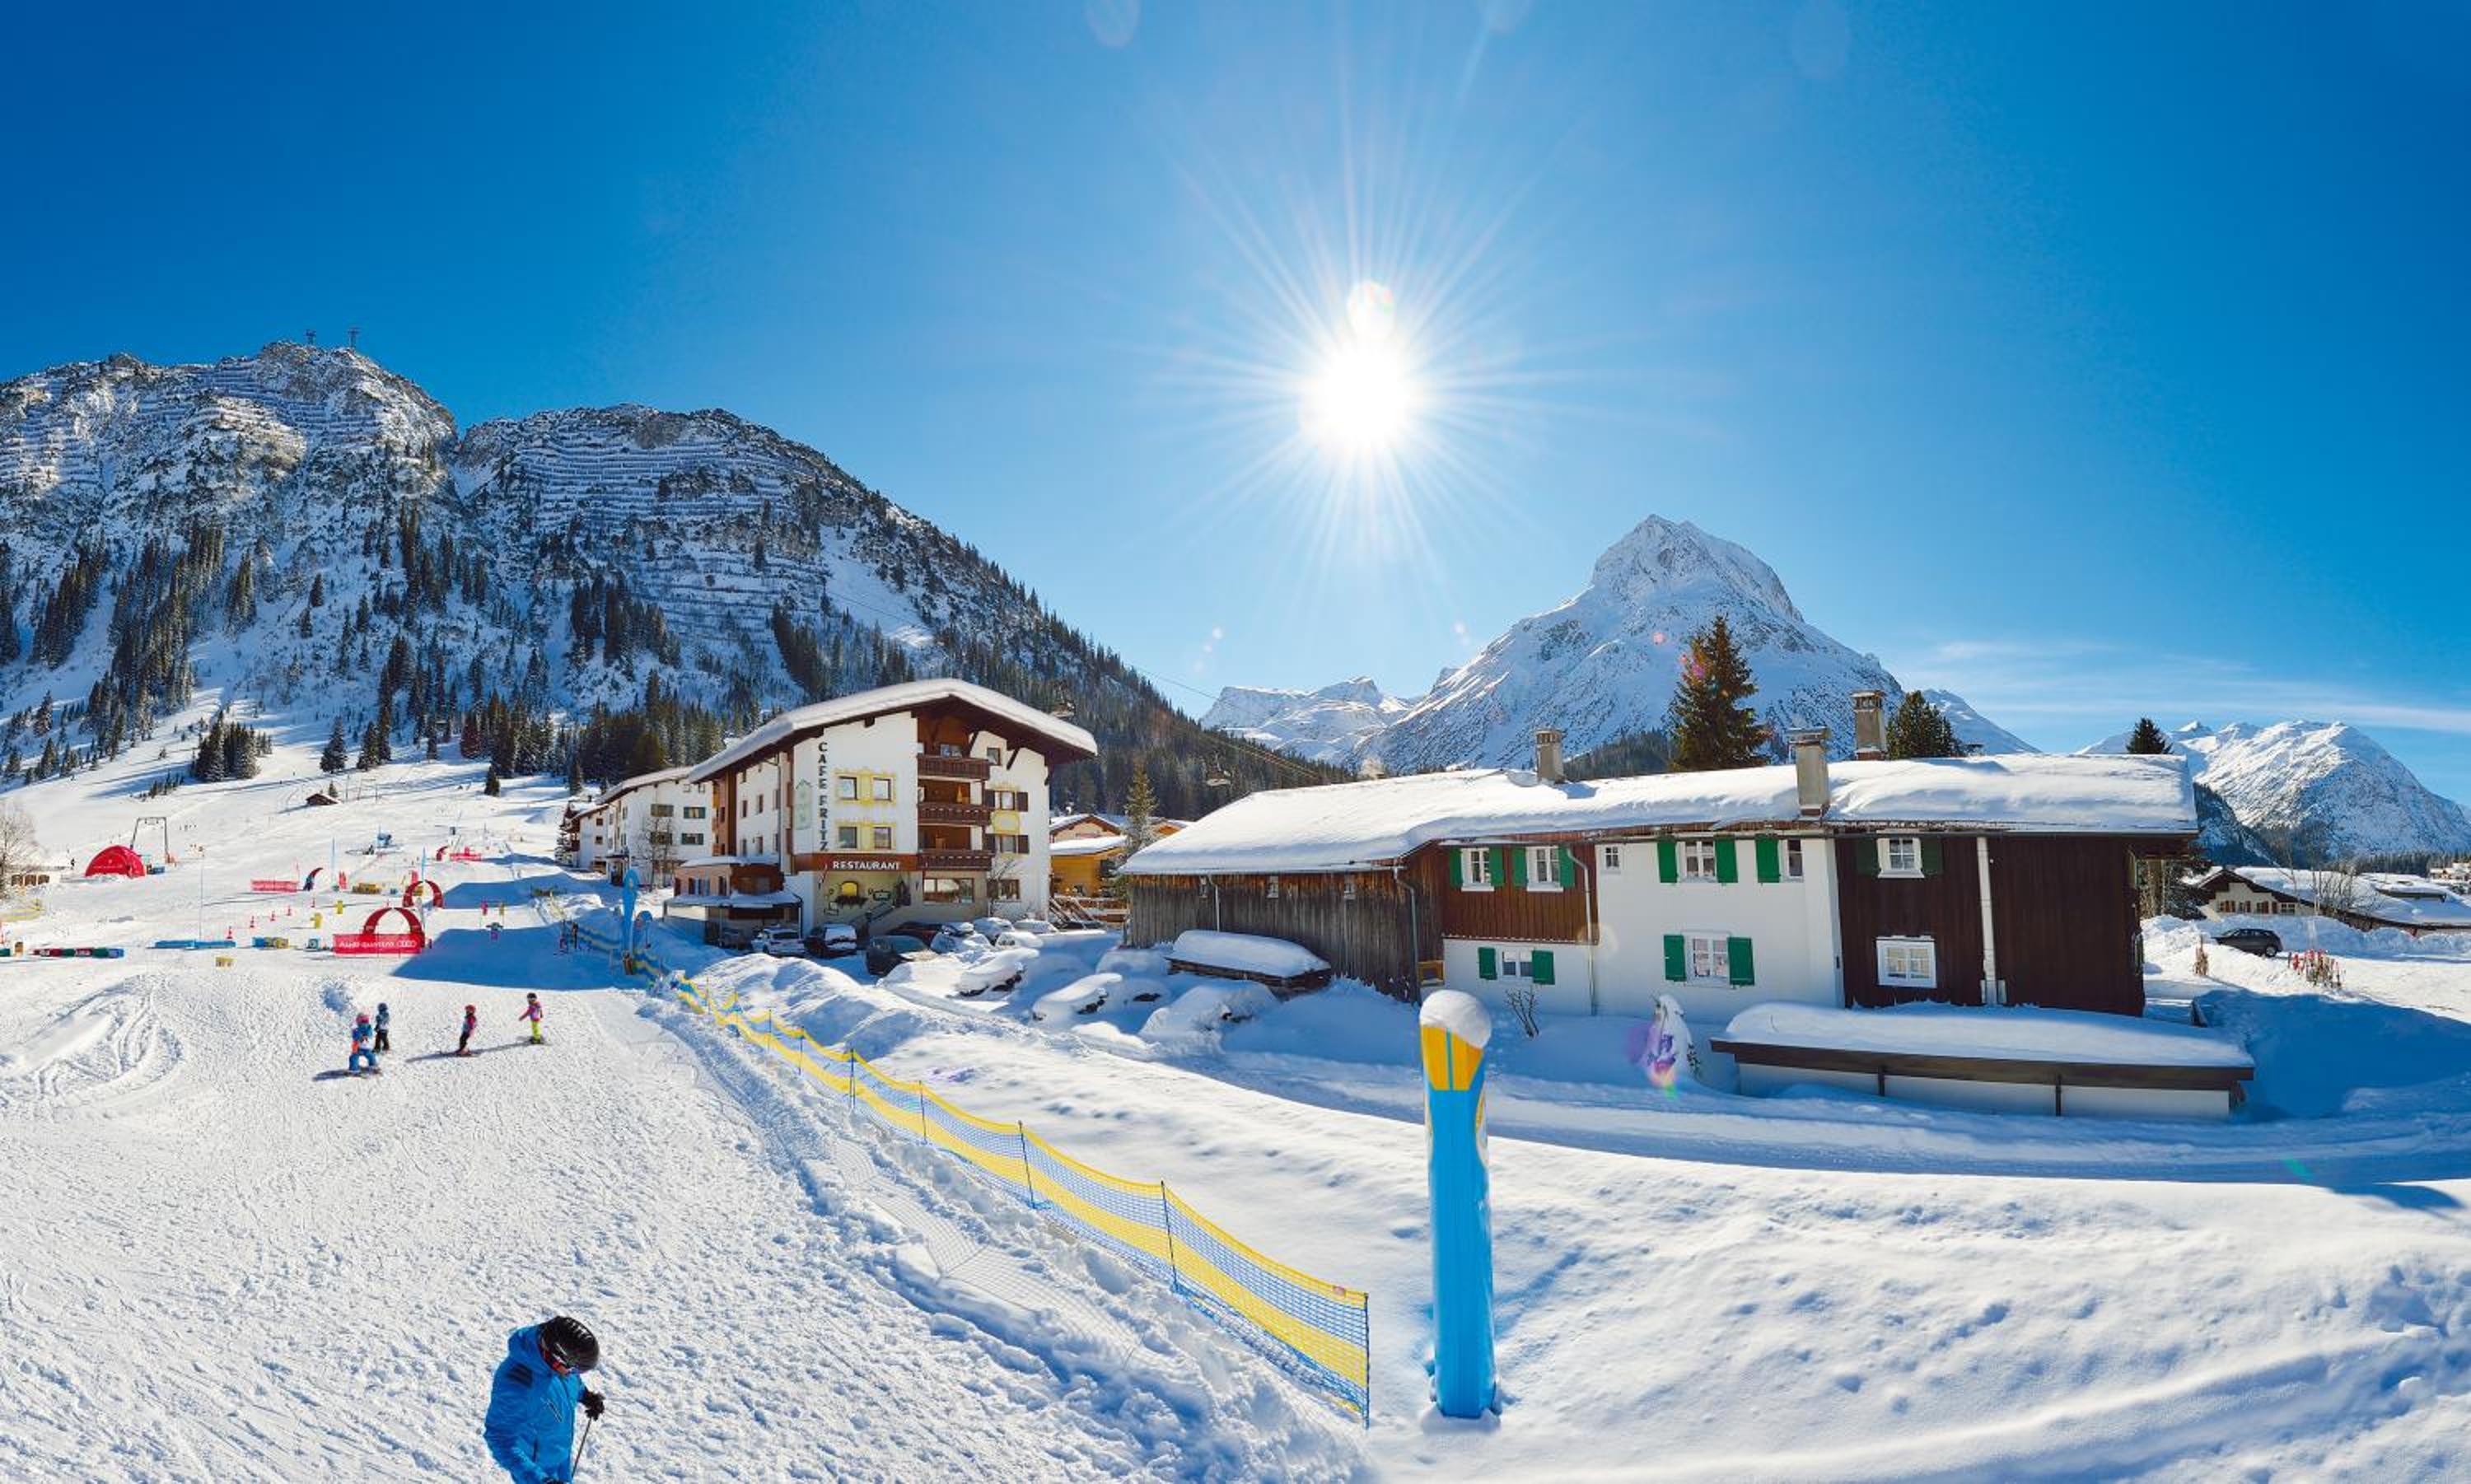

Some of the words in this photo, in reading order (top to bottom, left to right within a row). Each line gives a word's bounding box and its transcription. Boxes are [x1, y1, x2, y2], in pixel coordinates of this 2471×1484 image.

[818, 742, 828, 790] CAFE
[819, 795, 829, 852] FRITZ
[833, 861, 899, 870] RESTAURANT
